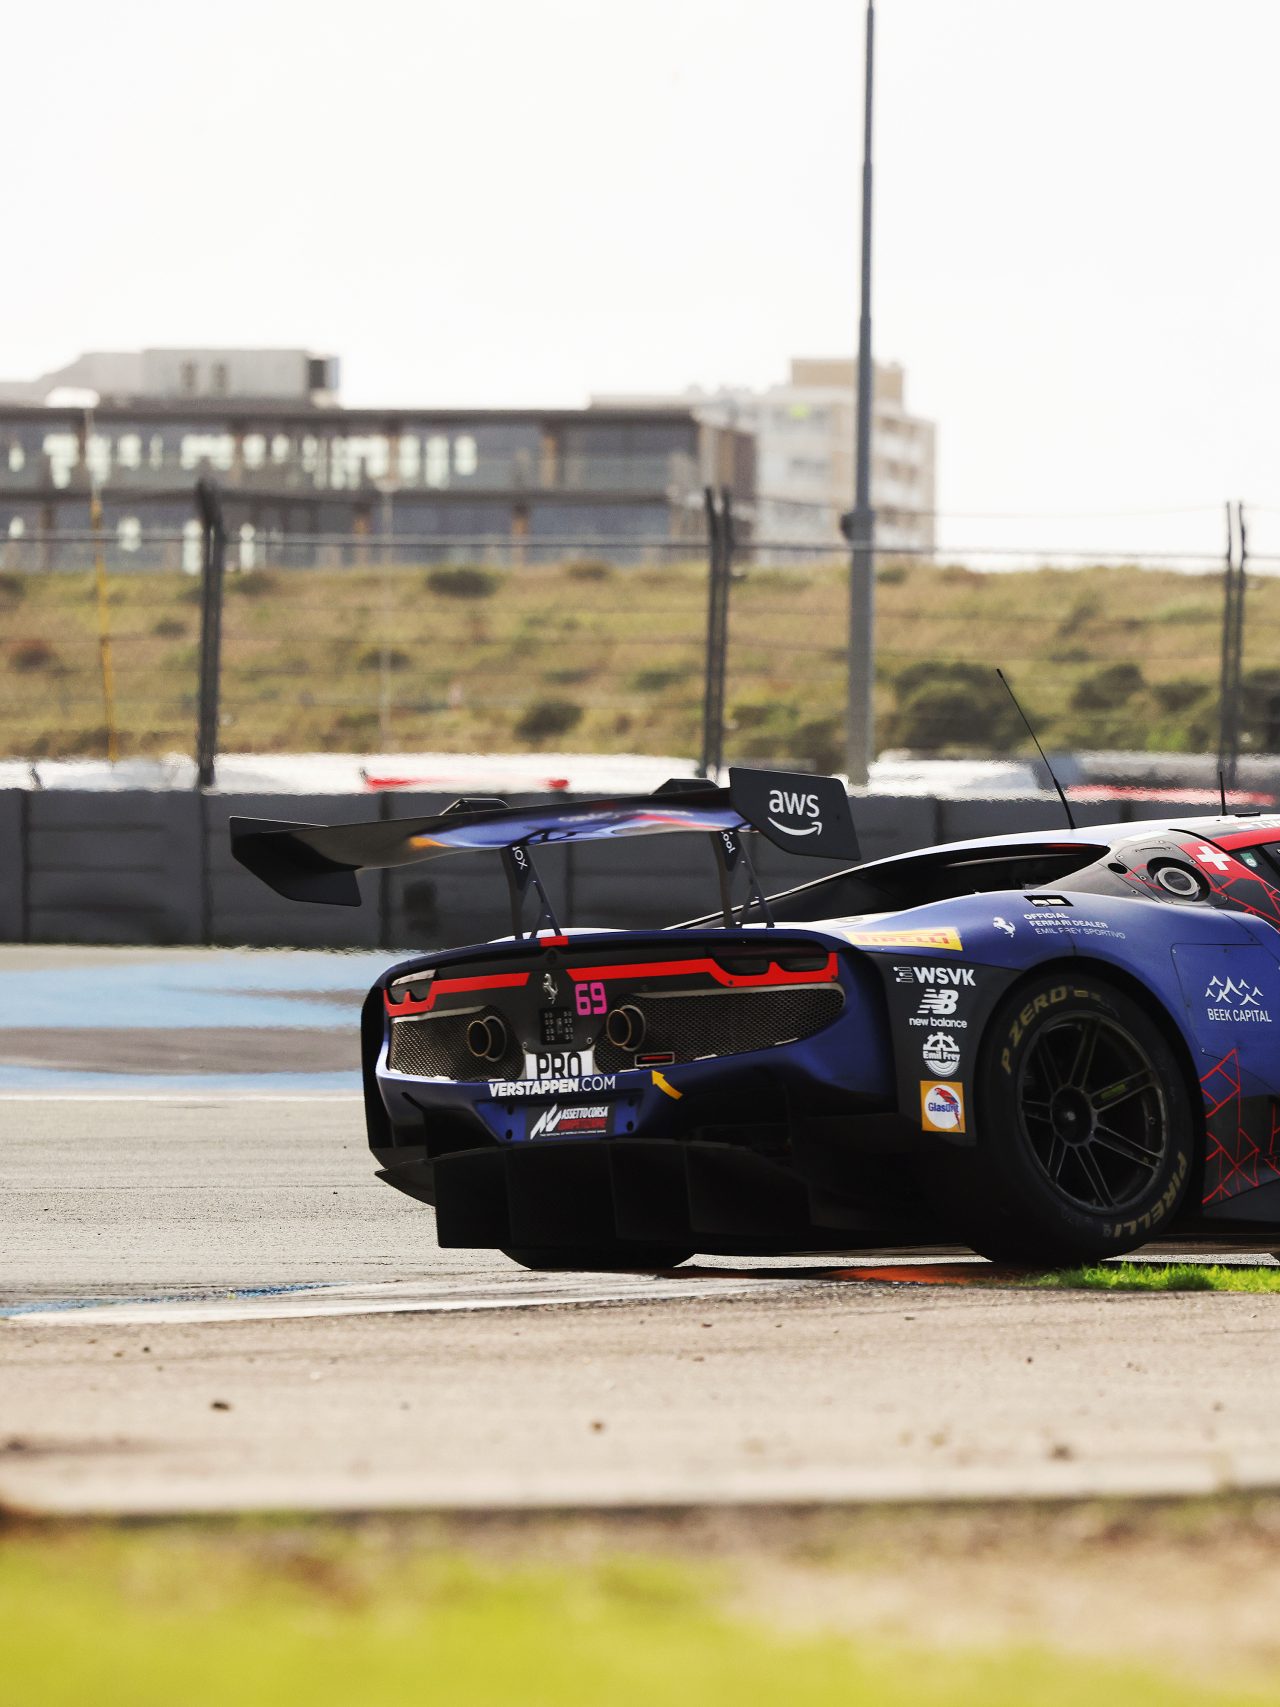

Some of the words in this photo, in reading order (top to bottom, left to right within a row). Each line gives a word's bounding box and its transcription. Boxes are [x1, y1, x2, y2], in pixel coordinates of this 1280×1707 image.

[769, 789, 820, 818] aws
[1023, 912, 1070, 920] OFFICIAL
[1029, 920, 1072, 928] FERRARI
[1073, 920, 1109, 929] DEALER
[1083, 928, 1126, 939] SPORTIVO
[912, 966, 977, 987] WSVK
[575, 982, 608, 1016] 69
[909, 1017, 929, 1027] new
[930, 1017, 968, 1029] balance
[1207, 1008, 1233, 1021] BEEK
[1233, 1009, 1273, 1023] CAPITAL
[1001, 1048, 1011, 1075] P
[1009, 985, 1068, 1048] ZERO
[537, 1051, 583, 1080] PRO
[923, 1050, 943, 1060] Emil
[943, 1052, 960, 1062] Frey
[488, 1075, 617, 1098] VERSTAPPEN.COM
[1113, 1151, 1188, 1238] PIRELLI
